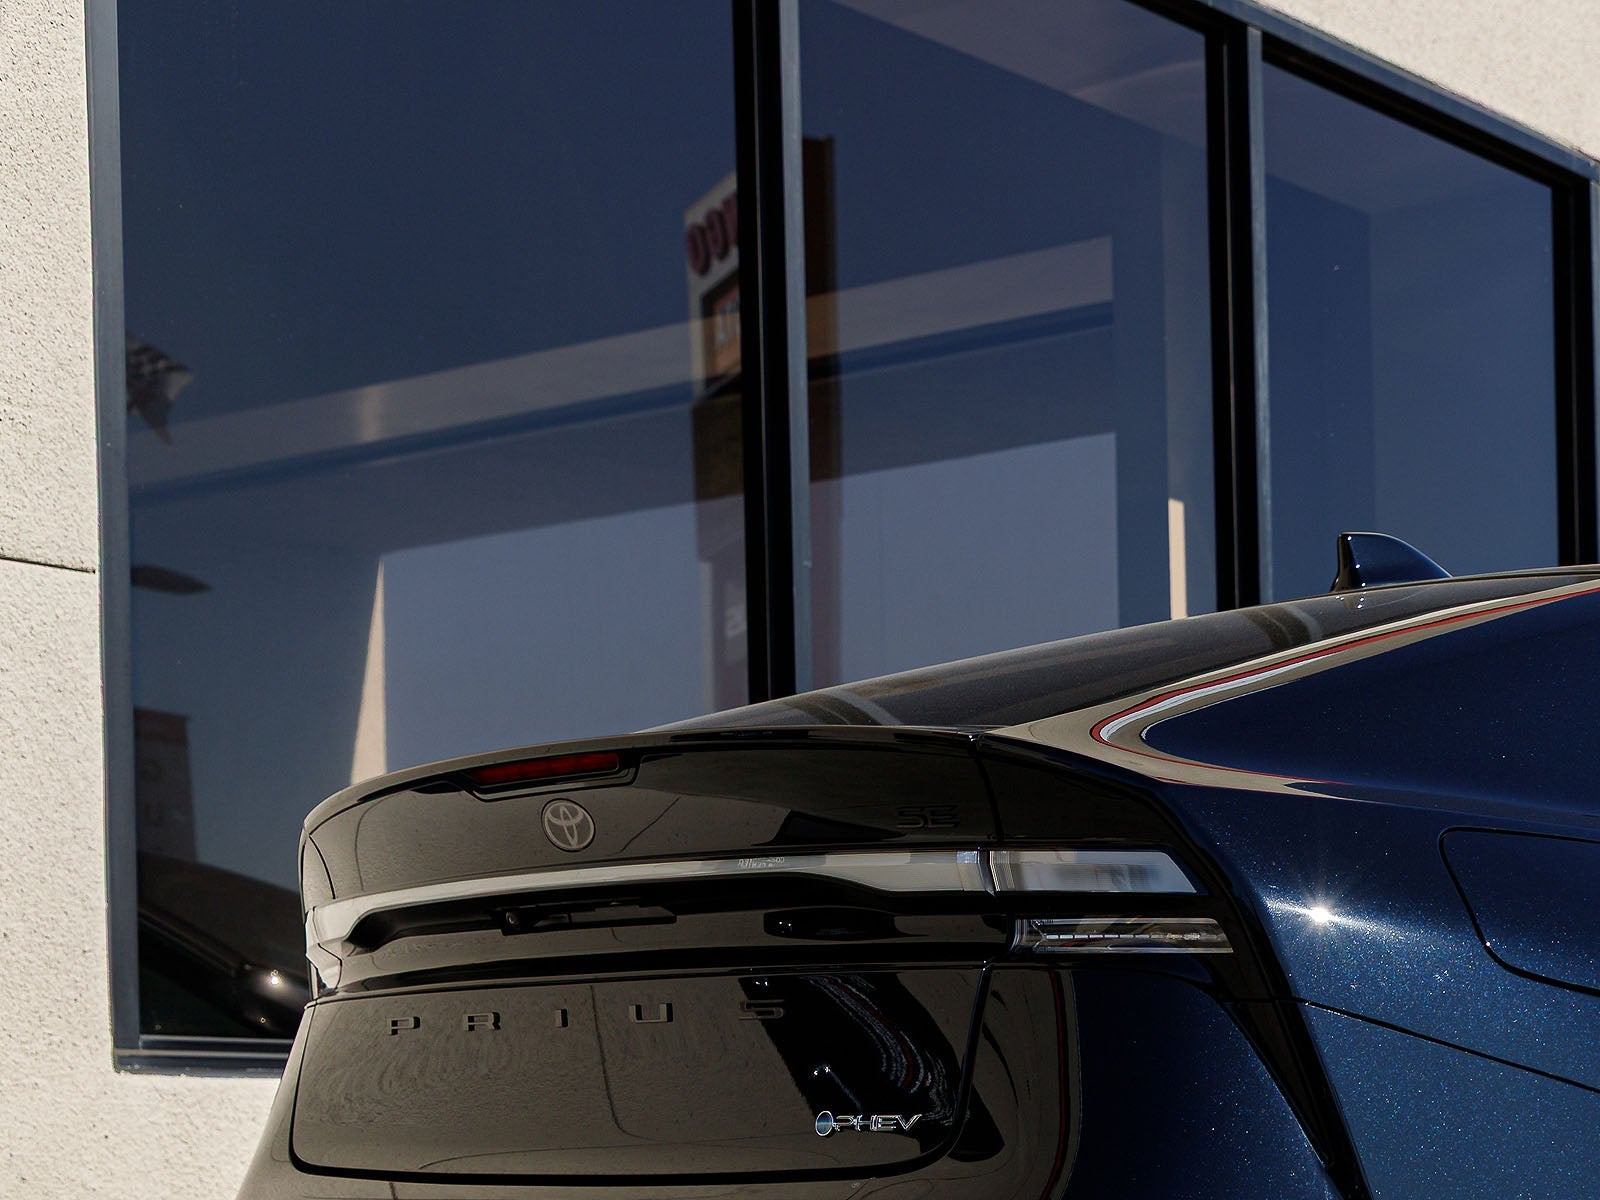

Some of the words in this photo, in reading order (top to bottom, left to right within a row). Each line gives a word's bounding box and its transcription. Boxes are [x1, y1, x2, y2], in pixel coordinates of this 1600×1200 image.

[896, 806, 957, 829] SE
[386, 1000, 785, 1036] PRIUS
[832, 1113, 922, 1132] PHEV
